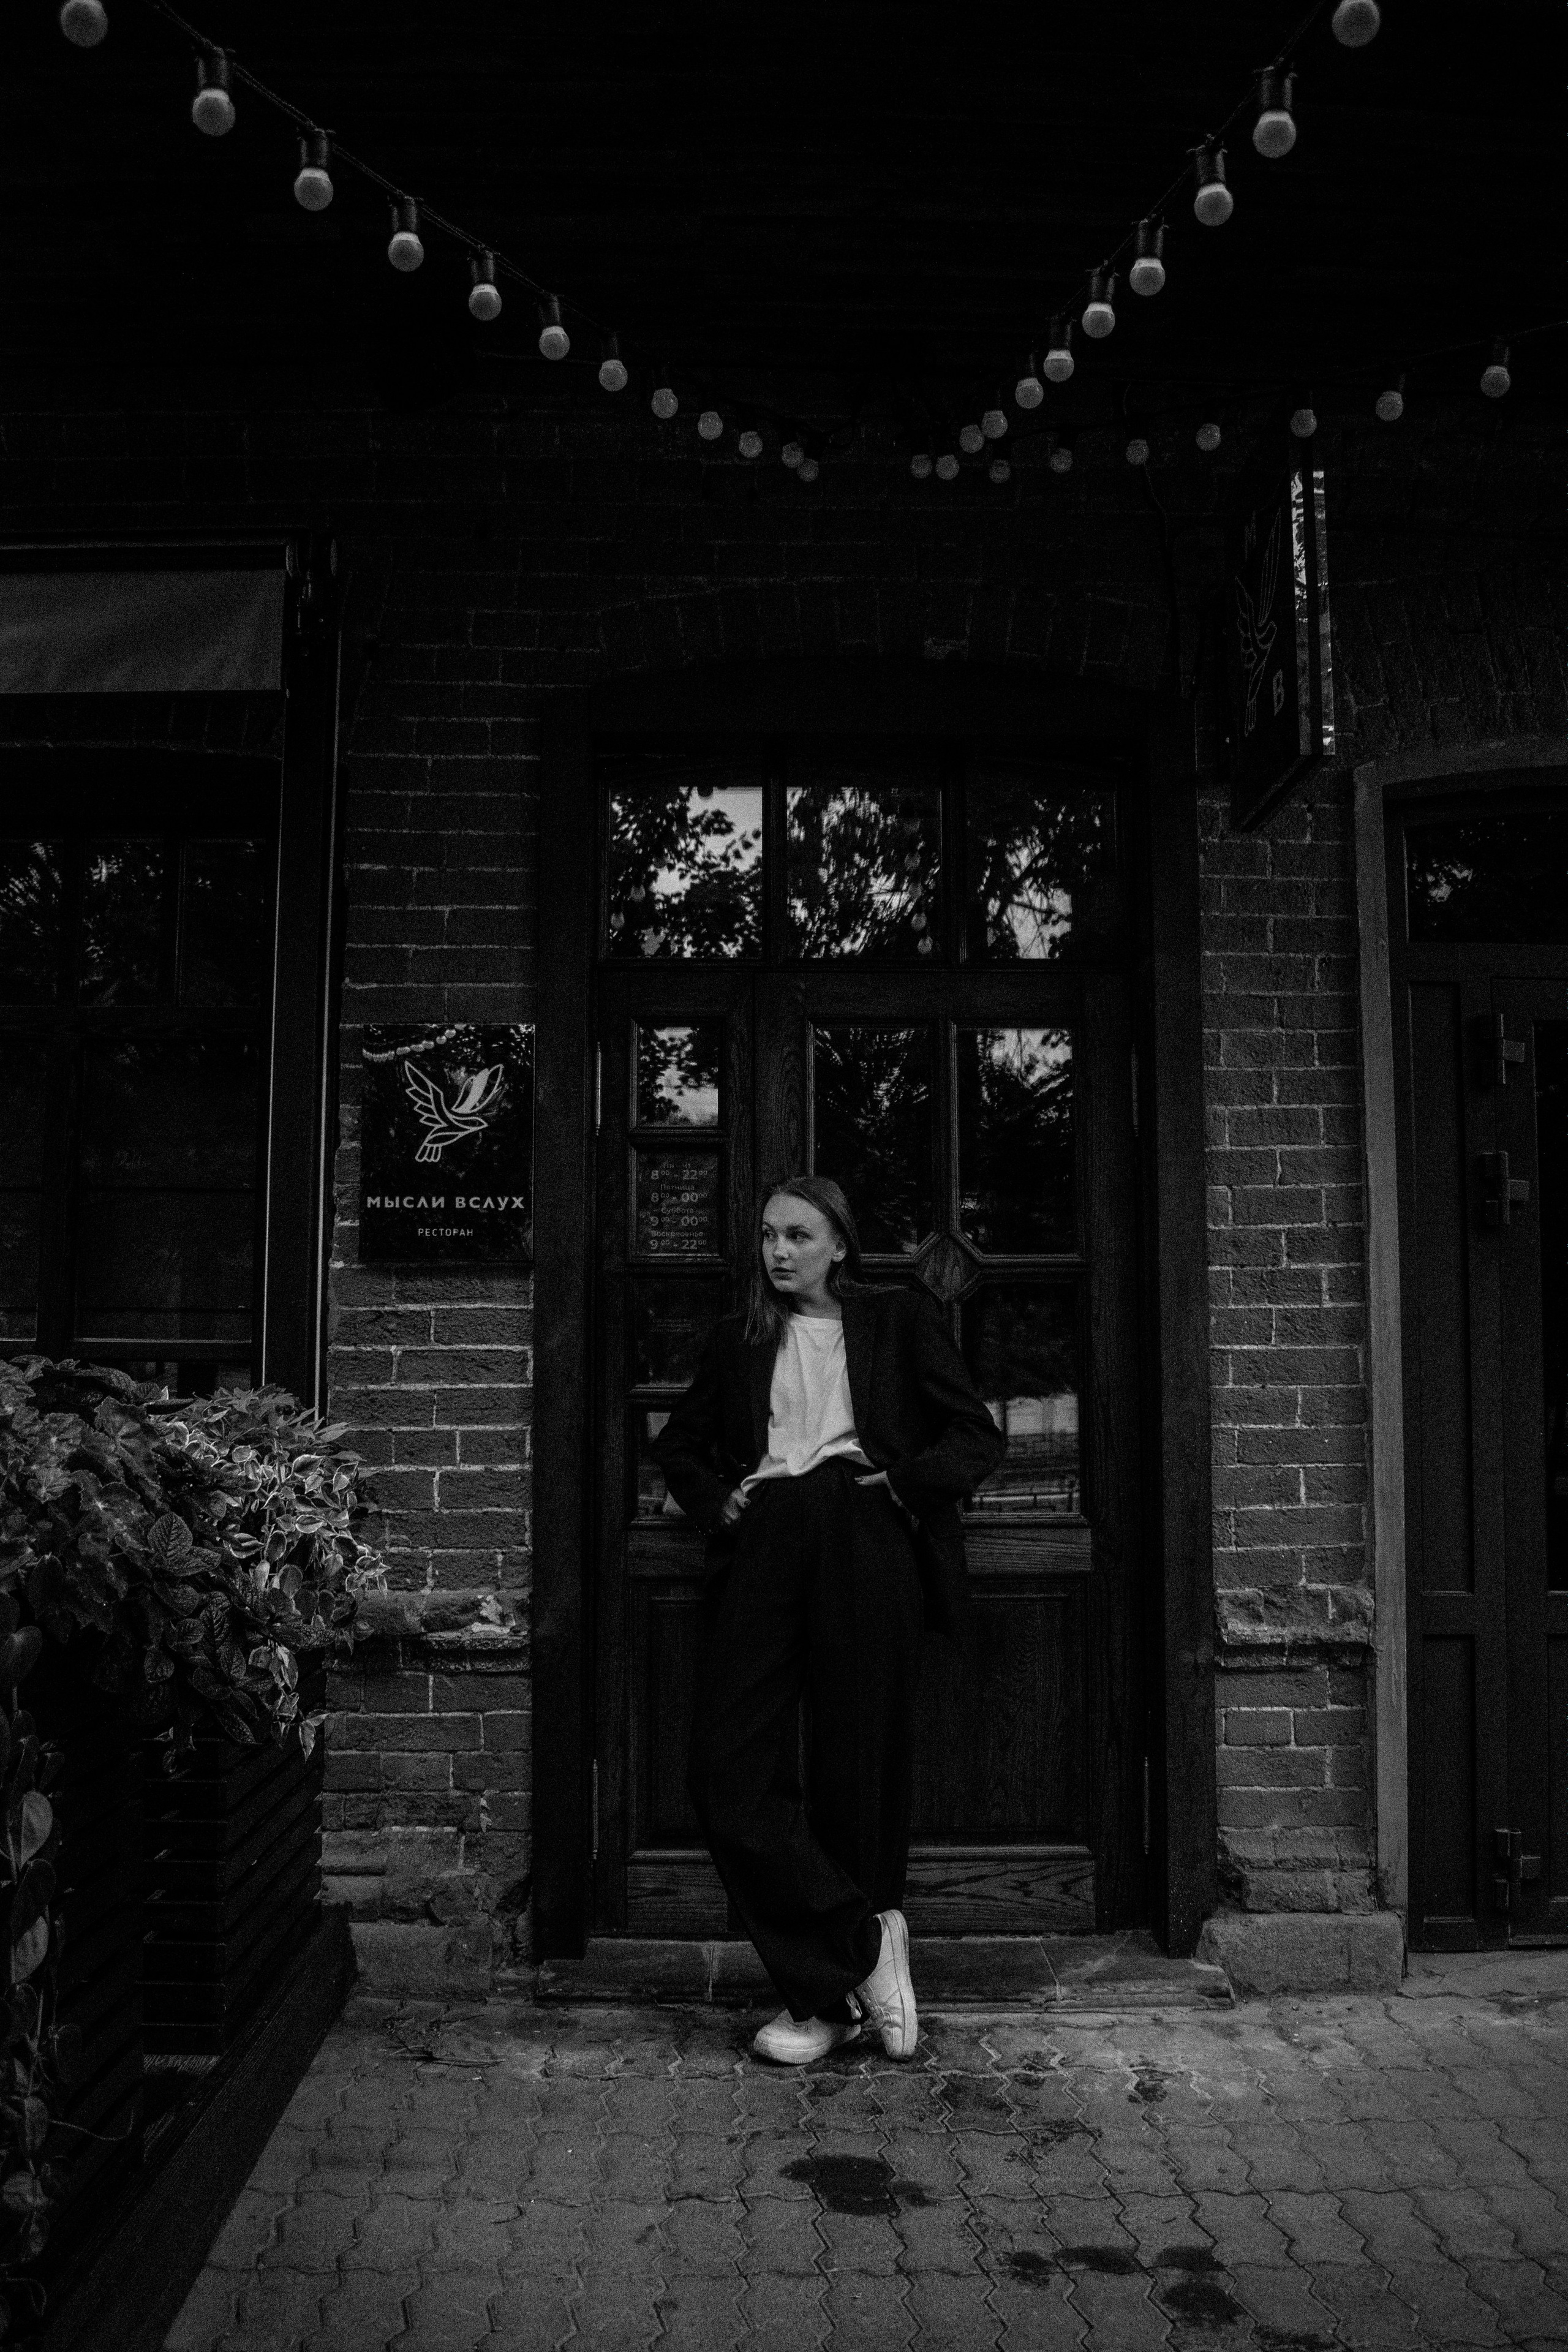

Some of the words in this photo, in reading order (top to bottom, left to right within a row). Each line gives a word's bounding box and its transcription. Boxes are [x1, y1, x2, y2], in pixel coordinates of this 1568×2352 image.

[367, 1196, 445, 1208] МЫСЛИ
[455, 1196, 525, 1211] ВСЛУХ
[417, 1228, 473, 1237] РЕСТОРАН
